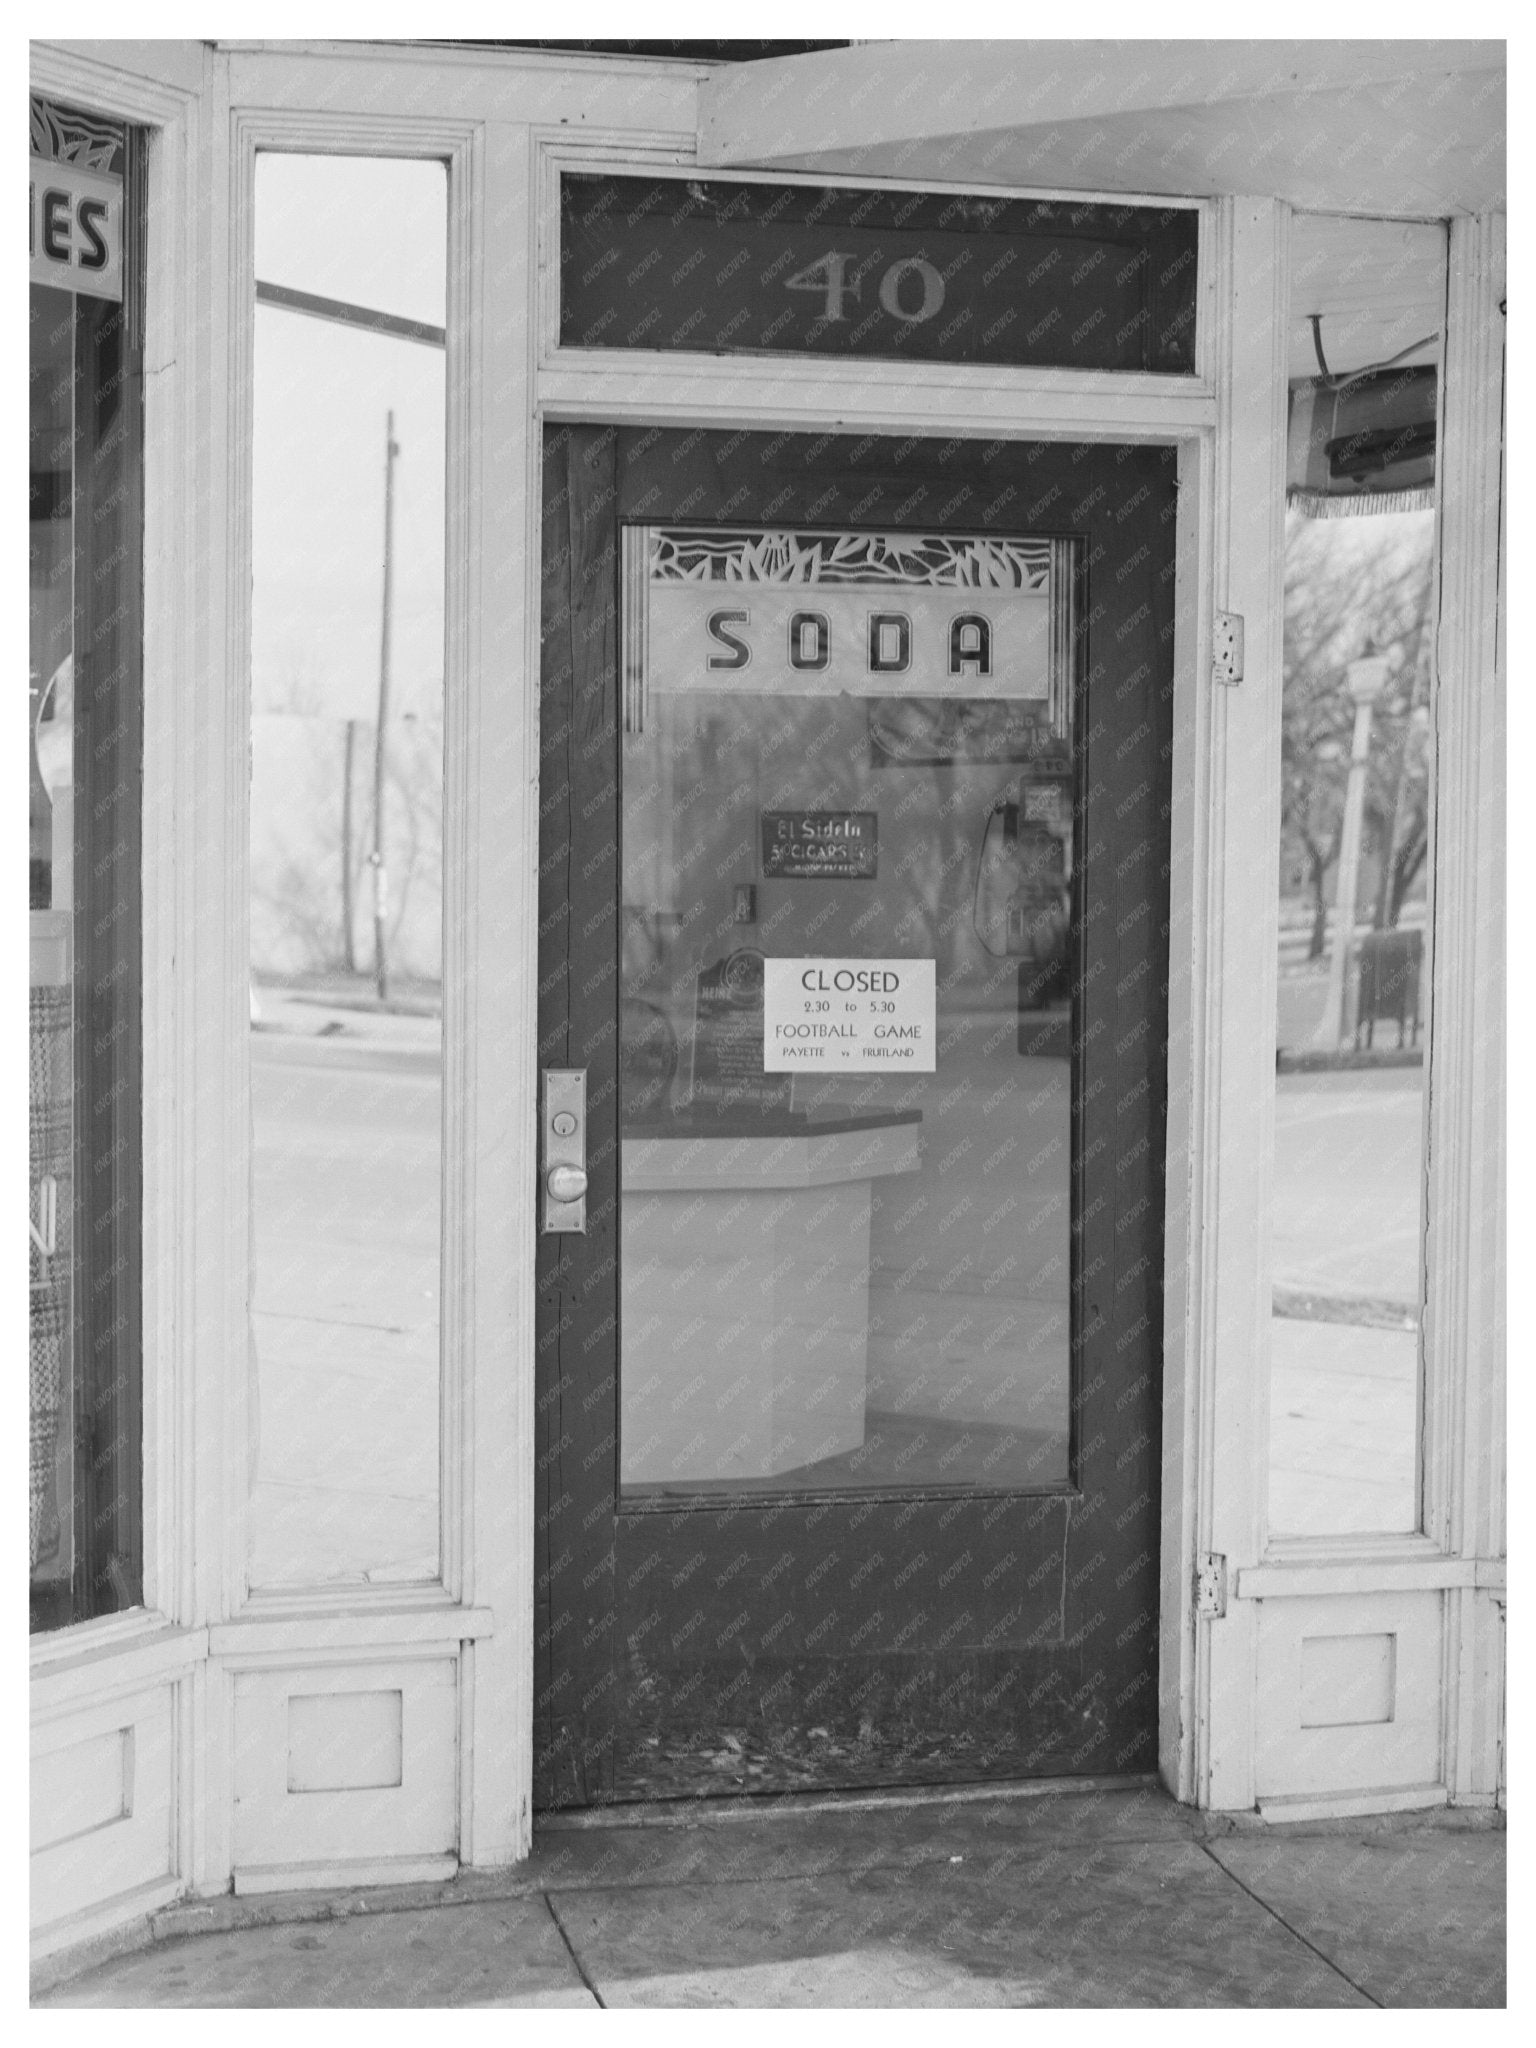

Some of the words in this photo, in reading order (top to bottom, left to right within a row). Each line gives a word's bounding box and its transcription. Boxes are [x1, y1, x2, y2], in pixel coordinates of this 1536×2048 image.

[30, 182, 109, 272] ES
[784, 252, 946, 324] 40
[706, 606, 993, 676] SODA
[801, 969, 900, 993] CLOSED
[804, 1000, 830, 1013] 2.30
[845, 1001, 857, 1012] to
[870, 1001, 896, 1013] 5.30
[776, 1024, 858, 1039] FOOTBALL
[874, 1025, 921, 1039] GAME
[783, 1047, 825, 1057] PAYETTE
[863, 1047, 914, 1057] FRUITLAND
